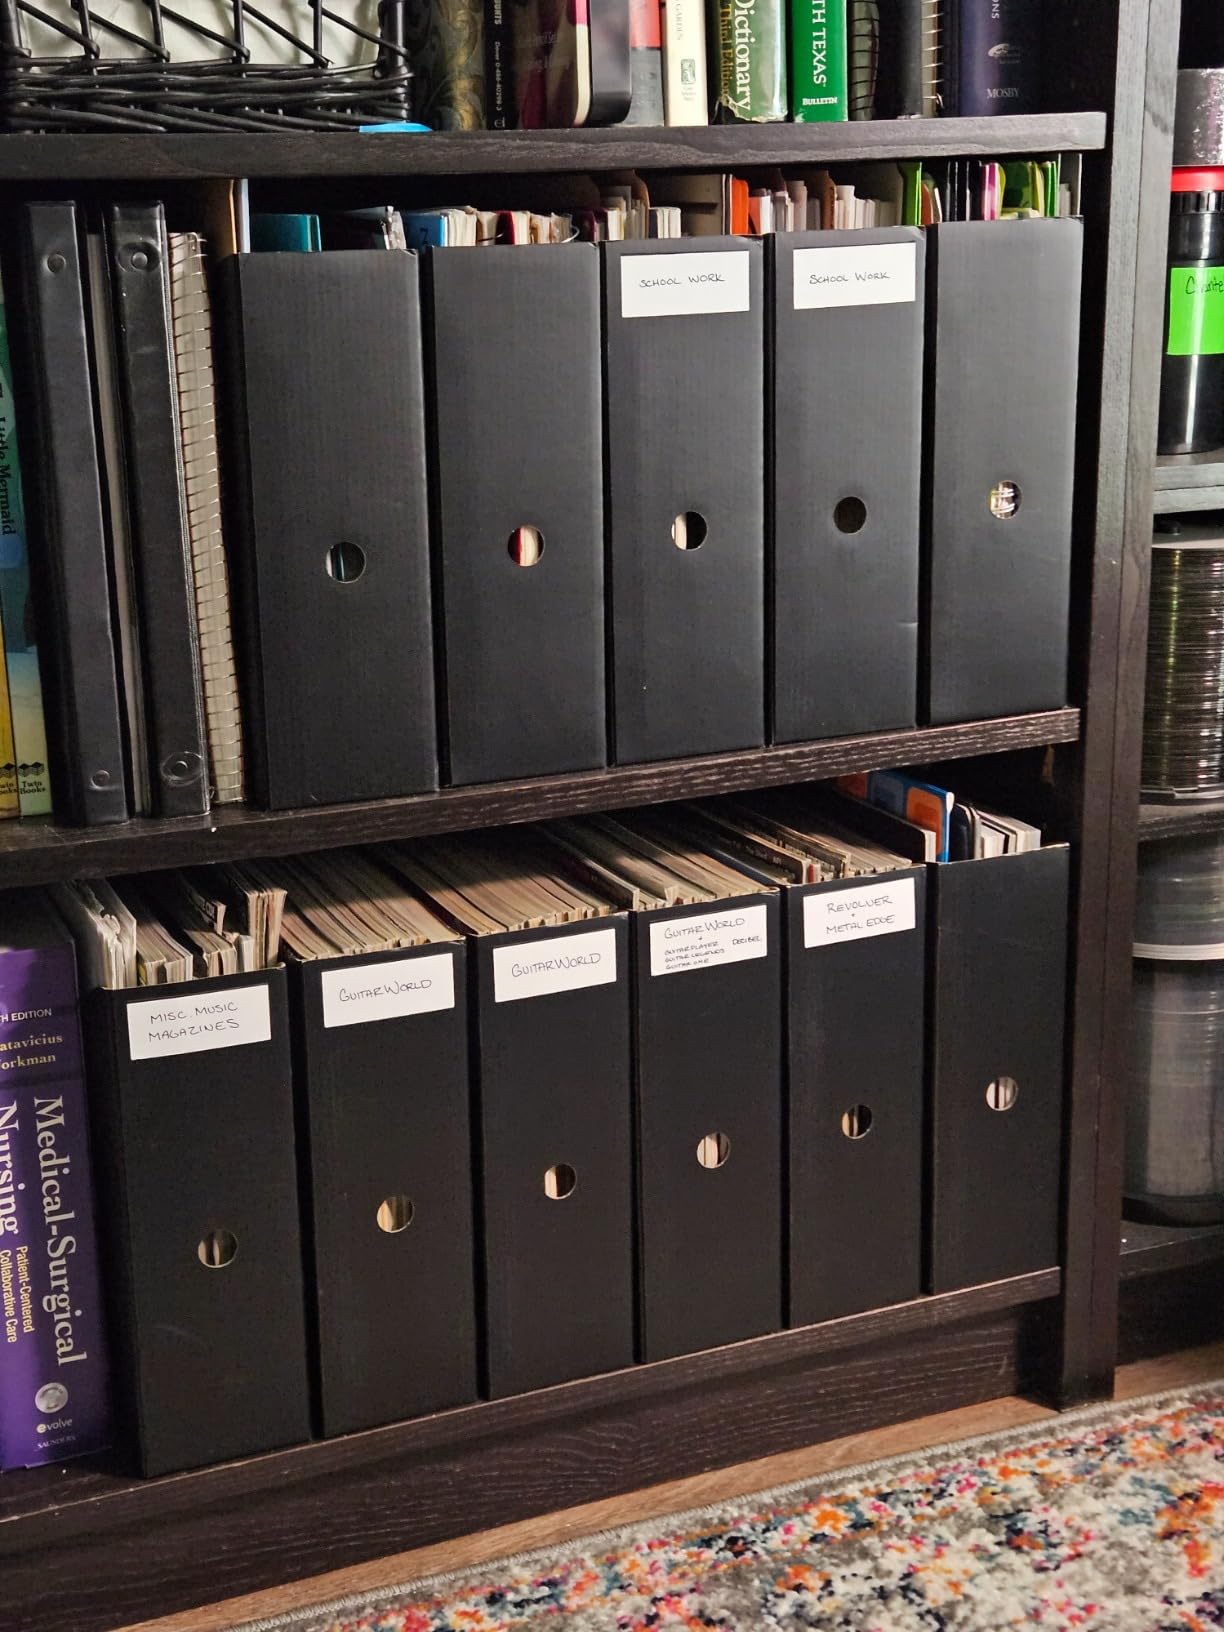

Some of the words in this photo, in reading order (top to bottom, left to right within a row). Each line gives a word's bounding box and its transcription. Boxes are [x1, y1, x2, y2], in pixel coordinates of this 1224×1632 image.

[720, 4, 733, 44] Third
[812, 27, 827, 84] TEXAS
[720, 48, 734, 96] Edition
[802, 96, 838, 105] BULLETIN
[986, 88, 1020, 99] MOSBY
[639, 278, 682, 288] SCHOOL
[688, 273, 725, 284] WORK
[809, 273, 849, 285] SCHOOL
[854, 271, 890, 281] WORK
[0, 463, 17, 536] Mermaid
[20, 786, 46, 794] Books
[664, 925, 704, 939] GUITAR
[704, 918, 745, 931] WORLD
[826, 922, 863, 935] METAL
[866, 914, 895, 927] EDGE
[11, 1008, 52, 1021] EDITION
[195, 1001, 238, 1016] MUSIC
[148, 1018, 240, 1042] MAGAZINES
[0, 1033, 63, 1051] atavicius
[0, 1054, 56, 1070] orkman
[0, 1100, 26, 1236] Nursing
[34, 1095, 88, 1366] Medical-Surgical
[0, 1249, 16, 1318] Collaborative
[16, 1245, 35, 1333] Patient-Centered
[5, 1318, 18, 1343] Care
[36, 1418, 73, 1434] evolve
